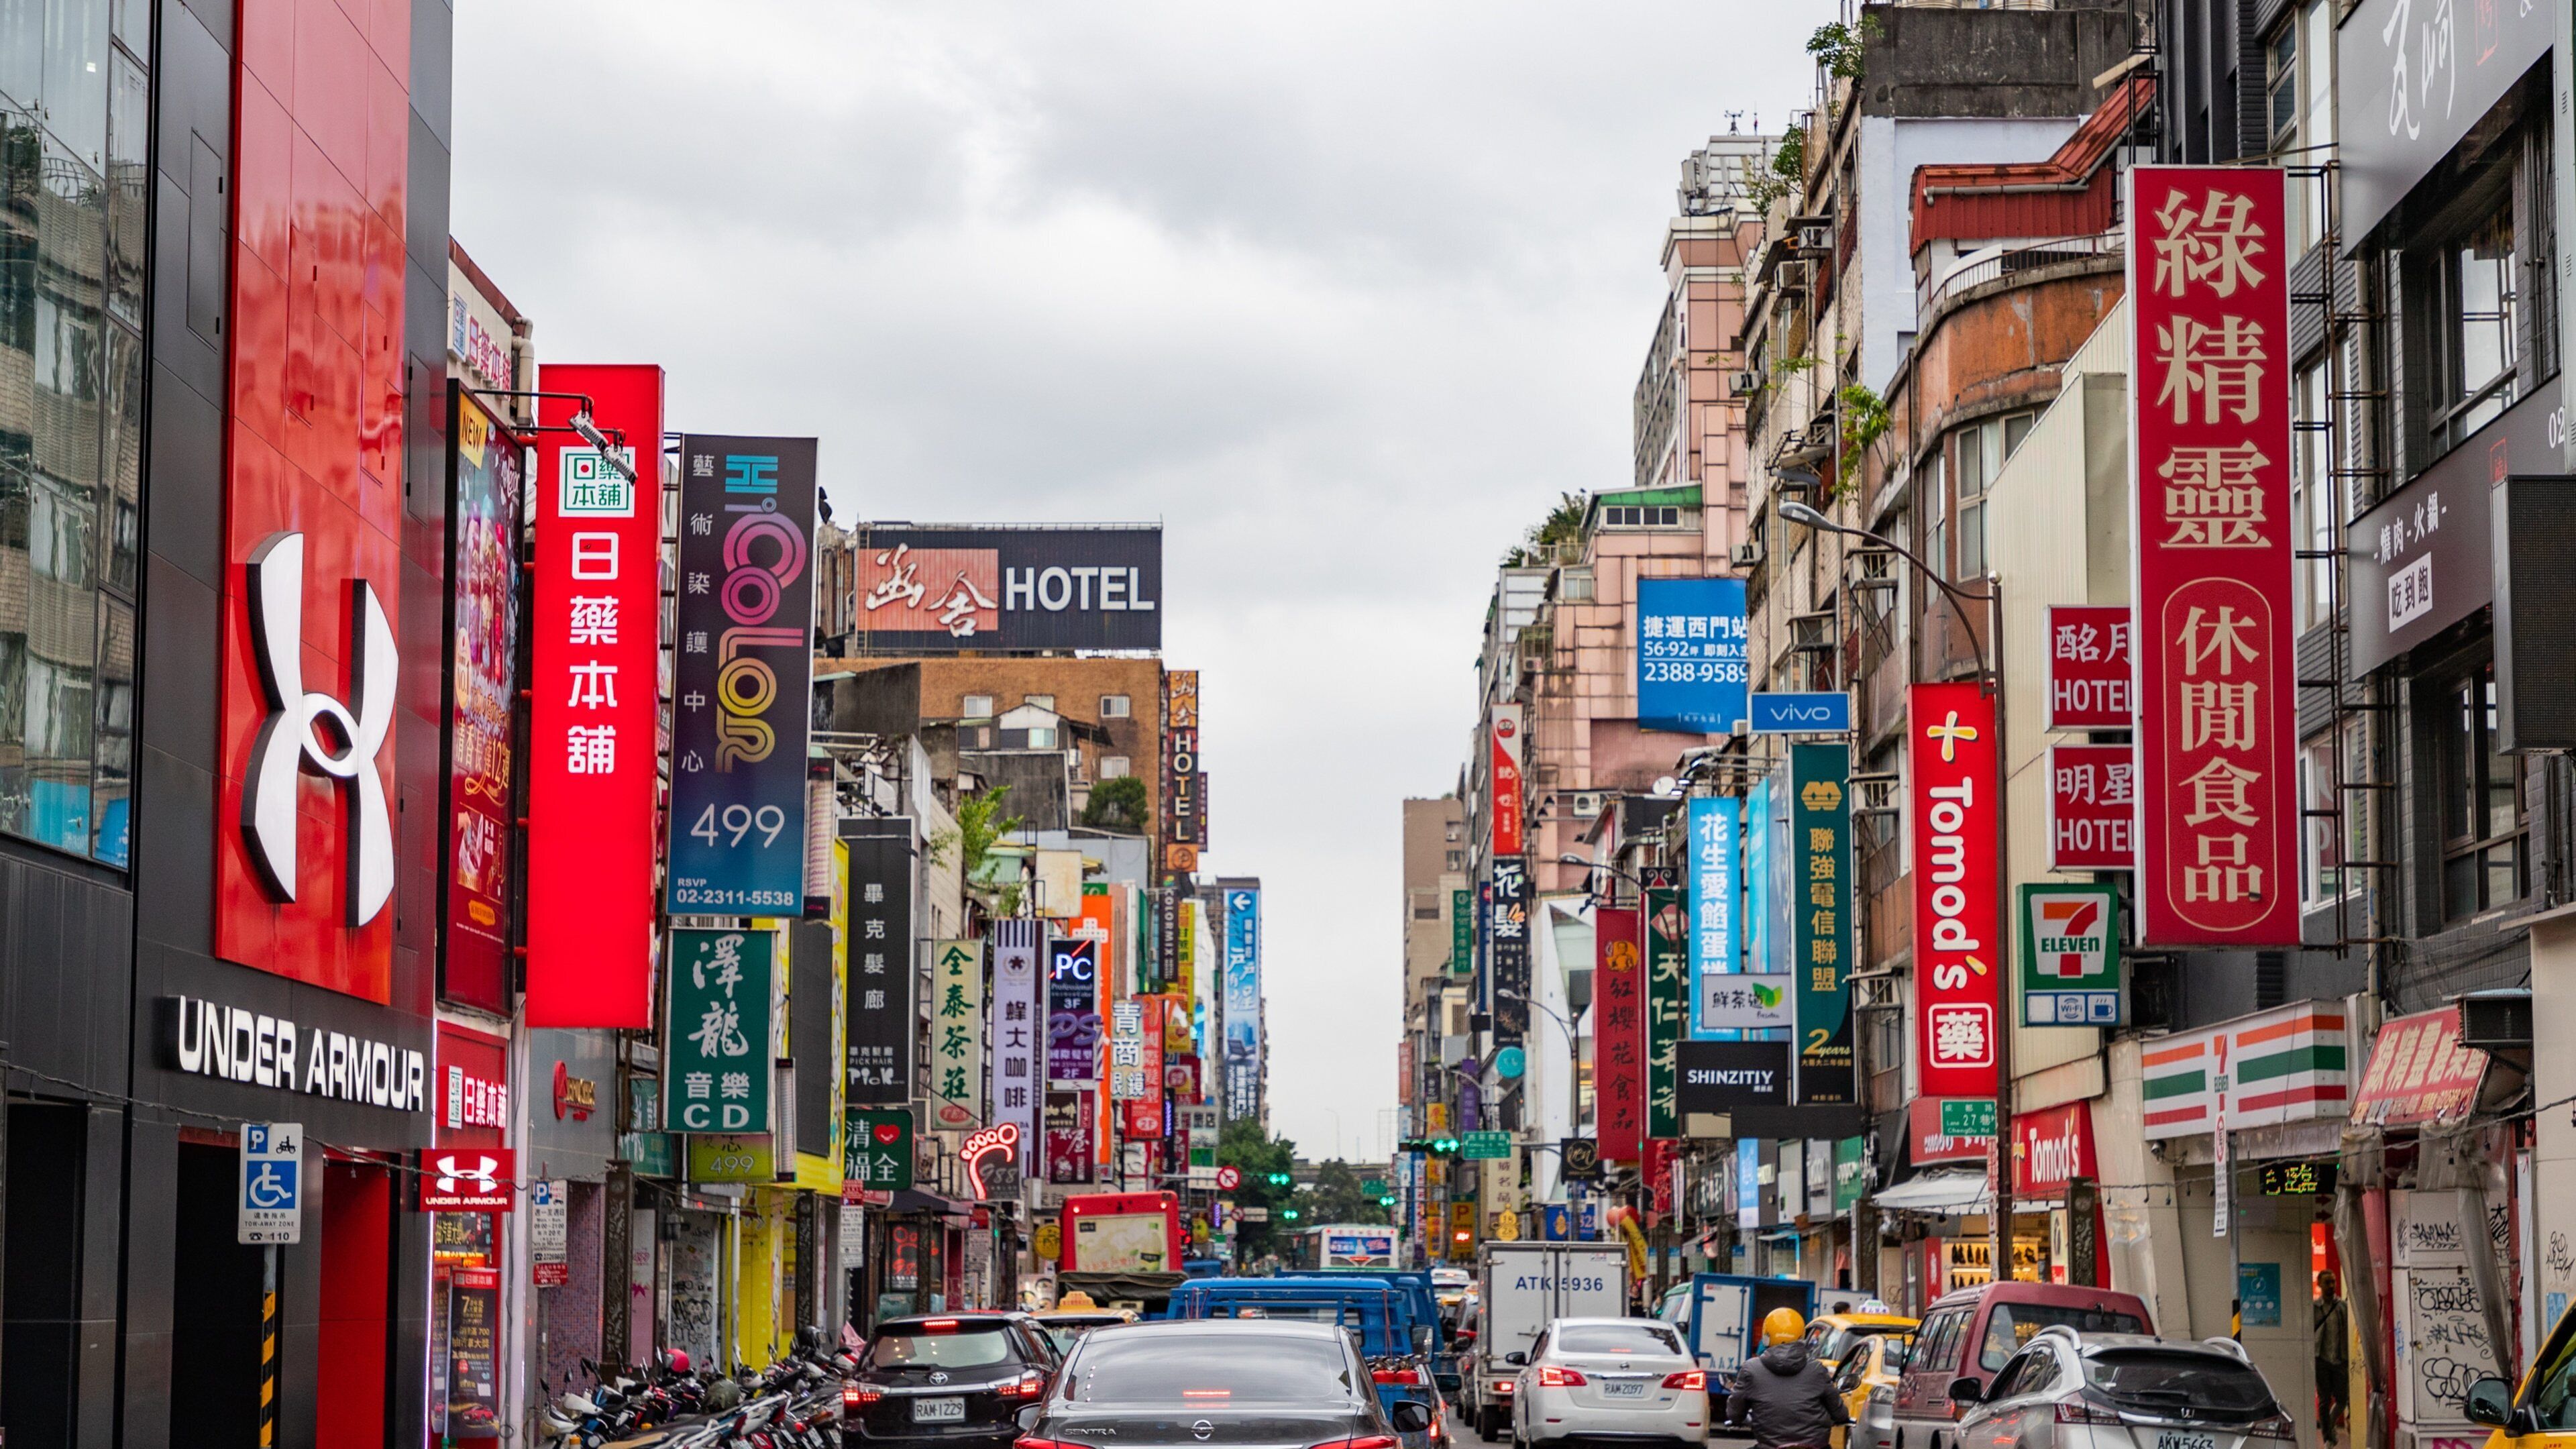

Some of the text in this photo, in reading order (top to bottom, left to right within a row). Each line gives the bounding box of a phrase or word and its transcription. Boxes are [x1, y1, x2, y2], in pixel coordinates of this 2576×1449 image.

[2152, 188, 2273, 549] 綠精靈
[462, 411, 482, 453] NEW
[572, 483, 622, 507] 本舖
[1006, 566, 1155, 611] HOTEL
[2391, 564, 2430, 620] 吃到飽
[682, 453, 715, 773] 藝術染護中心
[567, 531, 620, 775] 日藥本舖
[2055, 623, 2133, 664] 酩月
[1644, 662, 1748, 683] 2388-9589
[1770, 704, 1831, 721] vivo
[2053, 679, 2133, 712] HOTEL
[2174, 605, 2263, 903] 休閒食品
[1173, 733, 1193, 841] HOTEL
[2056, 763, 2134, 805] 明星
[690, 803, 786, 848] 499
[2056, 818, 2135, 853] HOTEL
[676, 888, 794, 906] 02-2311-5538
[677, 877, 708, 887] RSVP
[1927, 775, 1988, 991] Tomod's
[1164, 891, 1175, 957] COLORMIX
[1810, 827, 1837, 992] 聯強電信聯盟
[864, 883, 885, 1010] 畢克髮廊
[1056, 953, 1092, 981] PC
[686, 934, 749, 1059] 澤龍
[1063, 997, 1081, 1009] 3F
[1713, 990, 1763, 1009] 鮮茶道
[2060, 1003, 2083, 1014] Wi-Fi
[939, 946, 975, 1101] 全泰茶莊
[1112, 1002, 1141, 1067] 青商
[1936, 1010, 1985, 1061] 藥
[178, 994, 423, 1112] UNDER ARMOUR
[849, 1057, 894, 1066] PICK HAIR
[1005, 1000, 1027, 1108] 蜂大咖啡
[1803, 1028, 1851, 1058] 2 years
[684, 1071, 750, 1099] 音樂
[1062, 1068, 1081, 1079] 2F
[1687, 1069, 1773, 1085] SHINZITIY
[464, 1076, 507, 1128] 日藥本舖
[252, 1130, 265, 1150] P
[2028, 1108, 2080, 1184] Tomod's
[710, 1155, 755, 1174] 499
[978, 1163, 1019, 1184] 988
[425, 1196, 507, 1205] UNDER ARMOUR
[537, 1183, 547, 1204] P
[1456, 1205, 1468, 1220] P
[270, 1232, 290, 1241] 110
